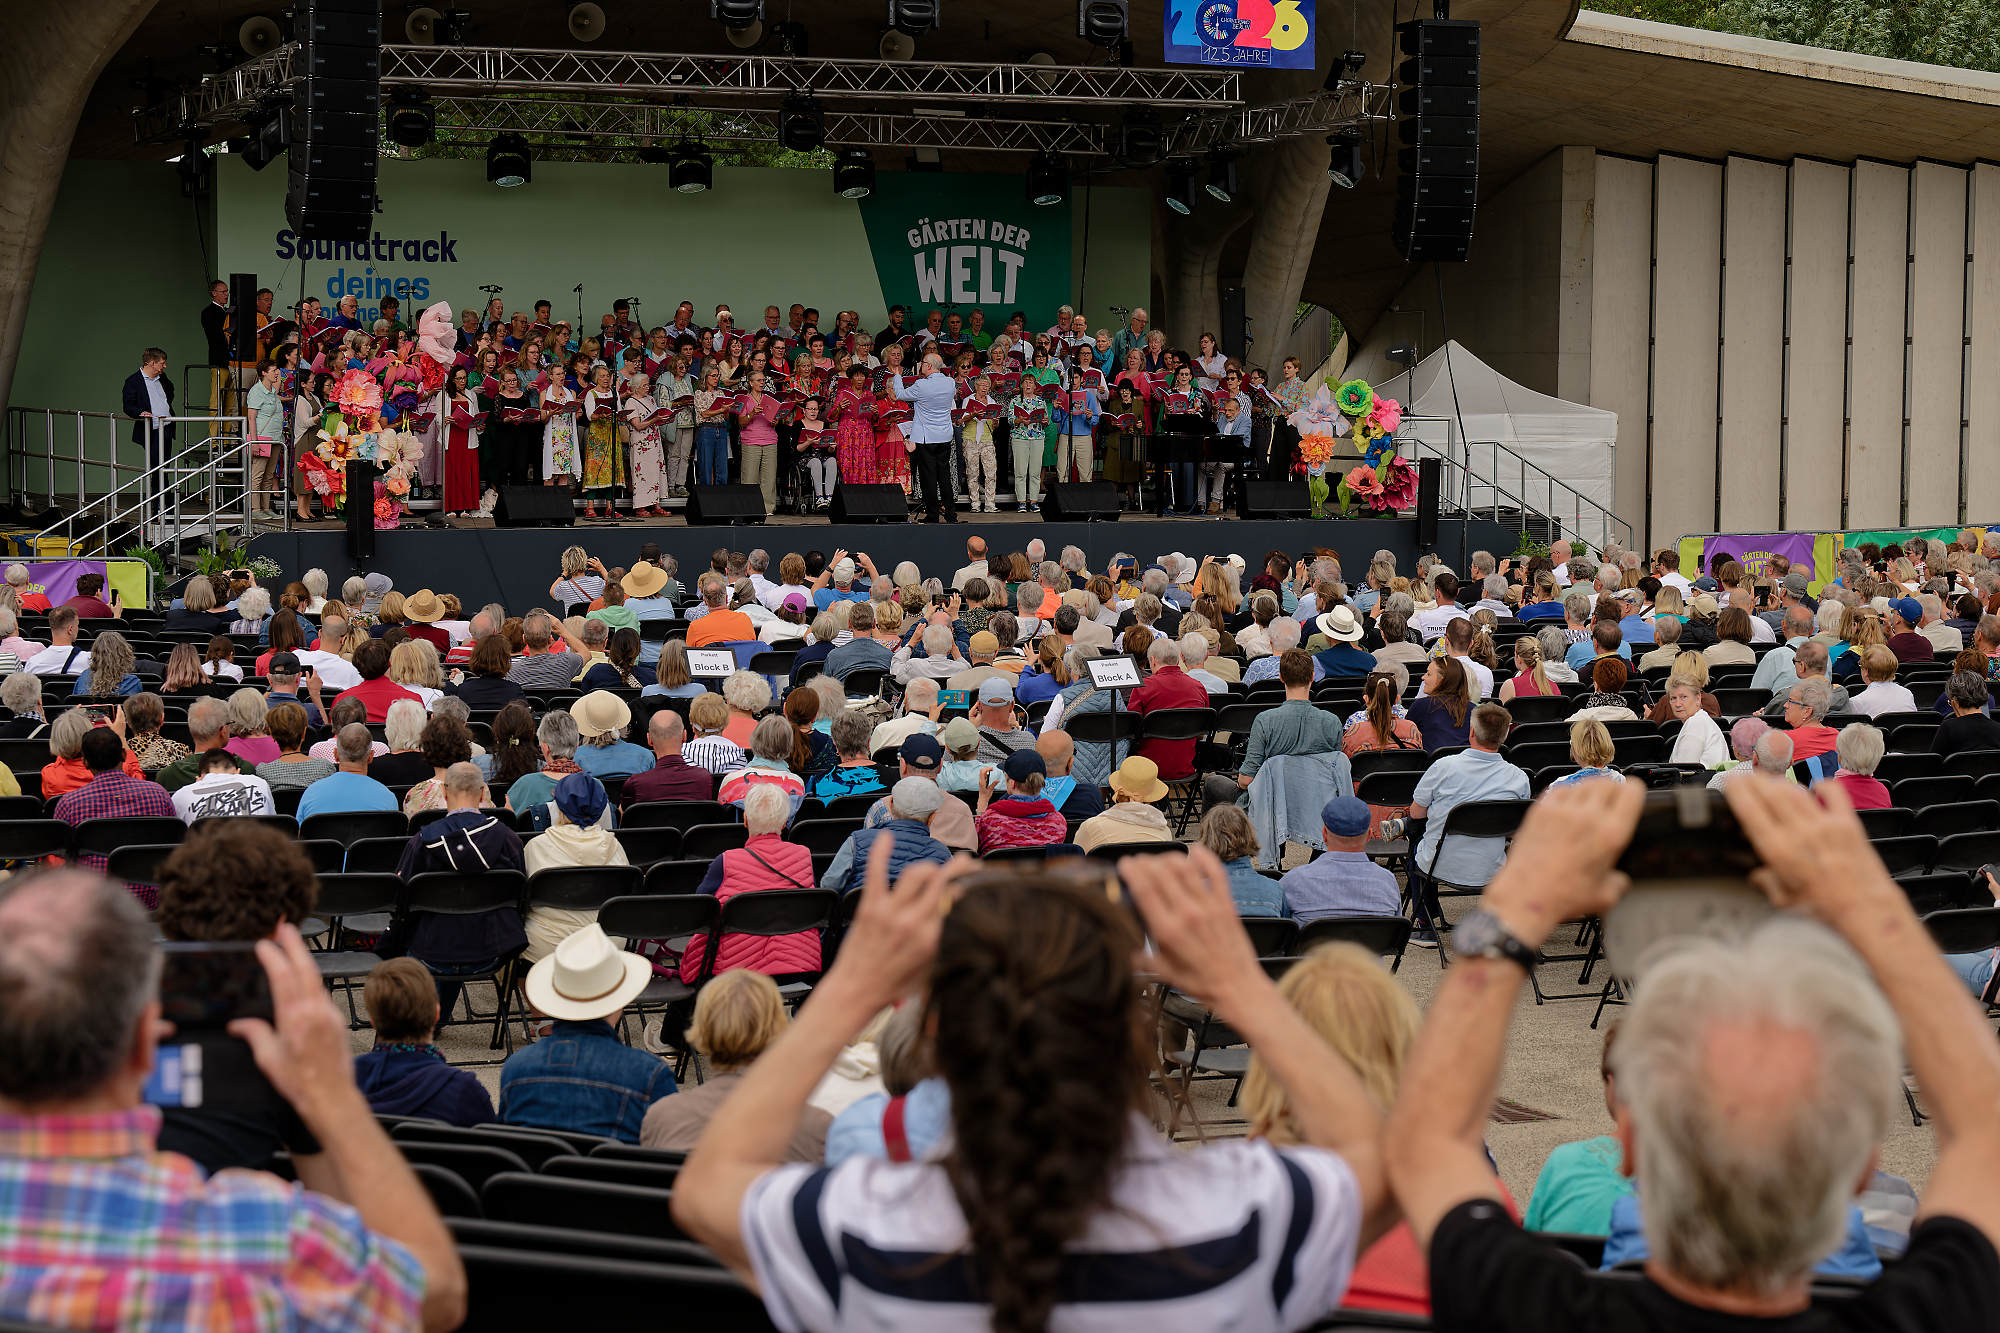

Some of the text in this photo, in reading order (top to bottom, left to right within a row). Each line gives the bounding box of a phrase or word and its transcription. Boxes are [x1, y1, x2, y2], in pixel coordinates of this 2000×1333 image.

[1204, 46, 1269, 62] 125 JAHRE
[907, 217, 1031, 250] GÄRTEN DER
[913, 245, 1025, 304] WELT
[326, 267, 431, 301] deines
[1741, 551, 1764, 562] GÄRTEN
[26, 582, 46, 594] DER
[694, 663, 721, 671] Block
[1097, 672, 1133, 683] Block A
